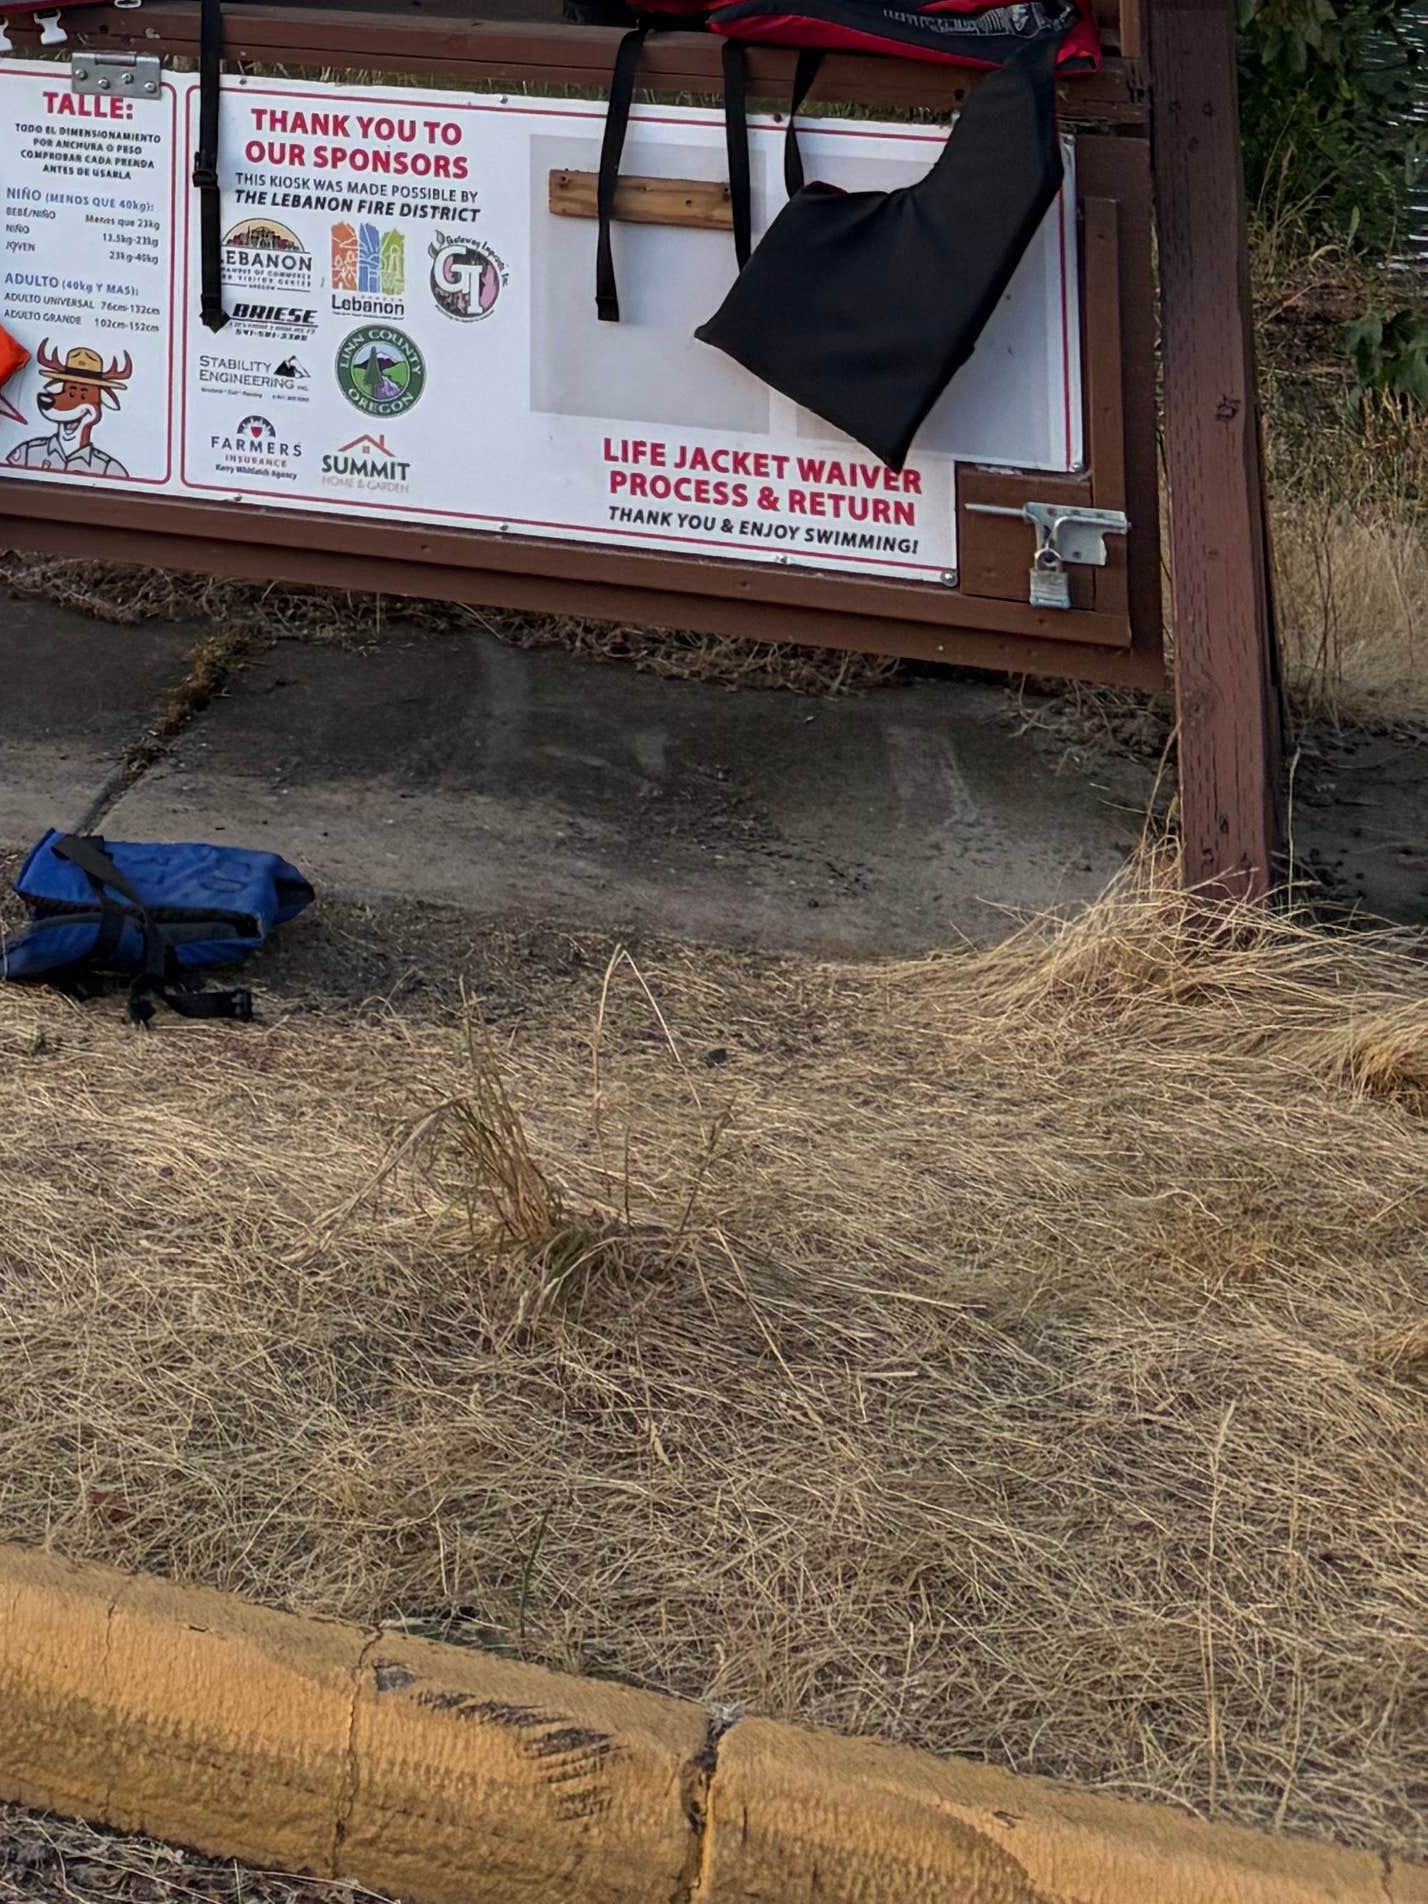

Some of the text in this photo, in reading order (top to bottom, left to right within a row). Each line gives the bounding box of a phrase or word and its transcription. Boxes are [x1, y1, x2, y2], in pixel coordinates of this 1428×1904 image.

[43, 91, 133, 120] TALLE:
[252, 108, 462, 146] THANK YOU TO
[245, 140, 468, 179] OUR SPONSORS
[6, 187, 42, 201] NIÑO
[92, 197, 115, 208] QUE
[236, 172, 478, 203] THIS KIOSK WAS MADE POSSIBLE BY
[236, 189, 481, 222] THE LEBANON FIRE DISTRICT
[222, 249, 312, 272] EBANON
[5, 272, 59, 288] ADULTO
[232, 303, 318, 324] BRIESE
[331, 294, 404, 315] Lebanon
[200, 355, 271, 372] STABILITY
[341, 329, 422, 375] LINN COUNTY
[200, 369, 295, 390] ENGINEERING
[348, 388, 415, 414] OREGON
[211, 435, 302, 458] FARMERS
[225, 454, 288, 468] INSURANCE
[321, 454, 411, 482] SUMMIT
[604, 437, 920, 494] LIFE JACKET WAIVER
[610, 470, 915, 526] PROCESS & RETURN
[610, 506, 919, 554] THANK YOU & ENJOY SWIMMING!
